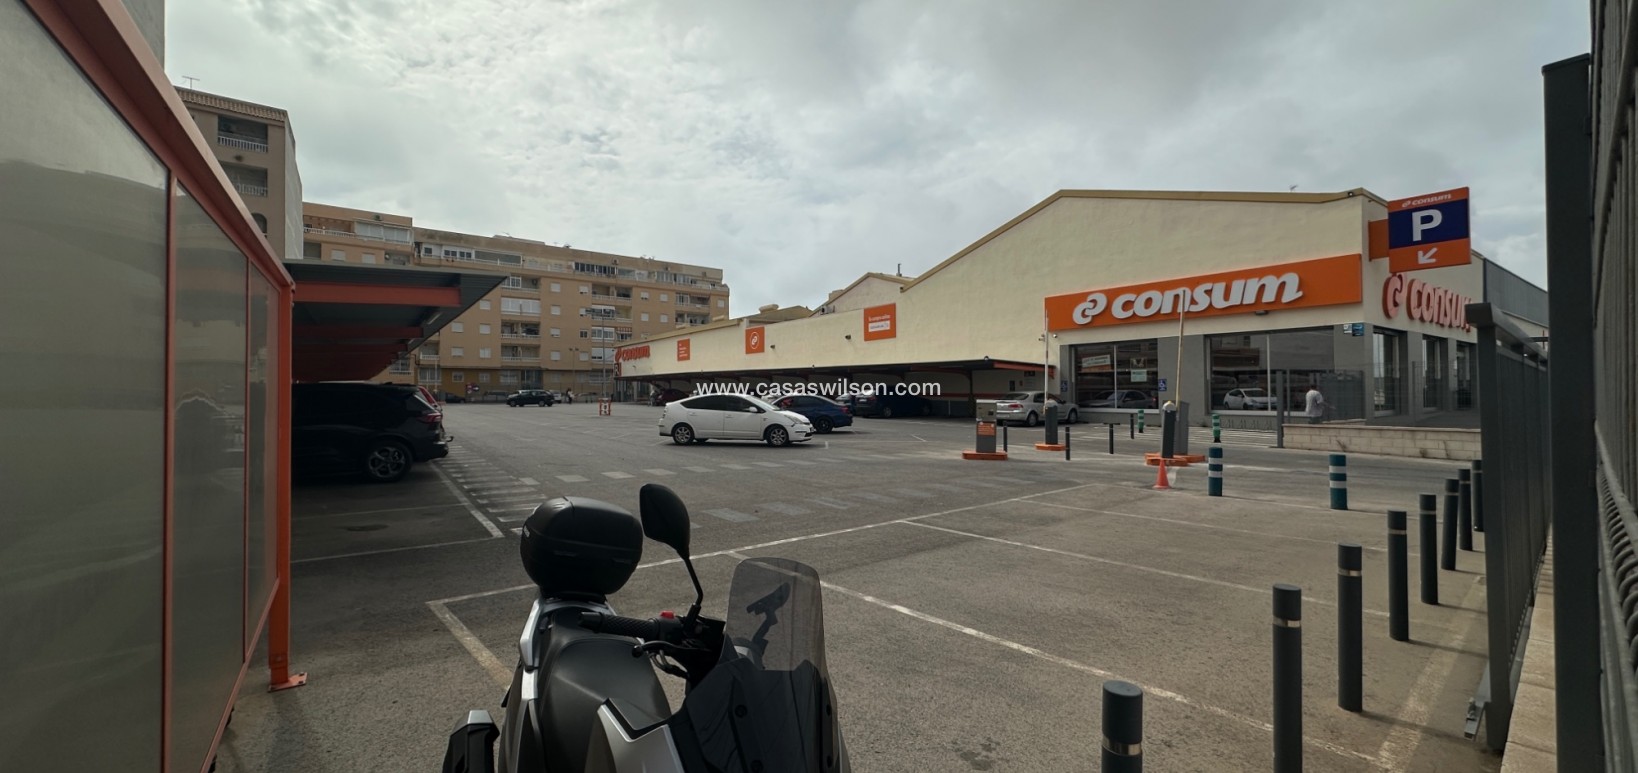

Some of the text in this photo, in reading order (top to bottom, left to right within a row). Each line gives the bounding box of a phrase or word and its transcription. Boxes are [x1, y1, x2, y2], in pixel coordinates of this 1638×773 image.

[1412, 193, 1452, 206] consum
[1411, 208, 1443, 242] P
[1111, 272, 1303, 319] consum
